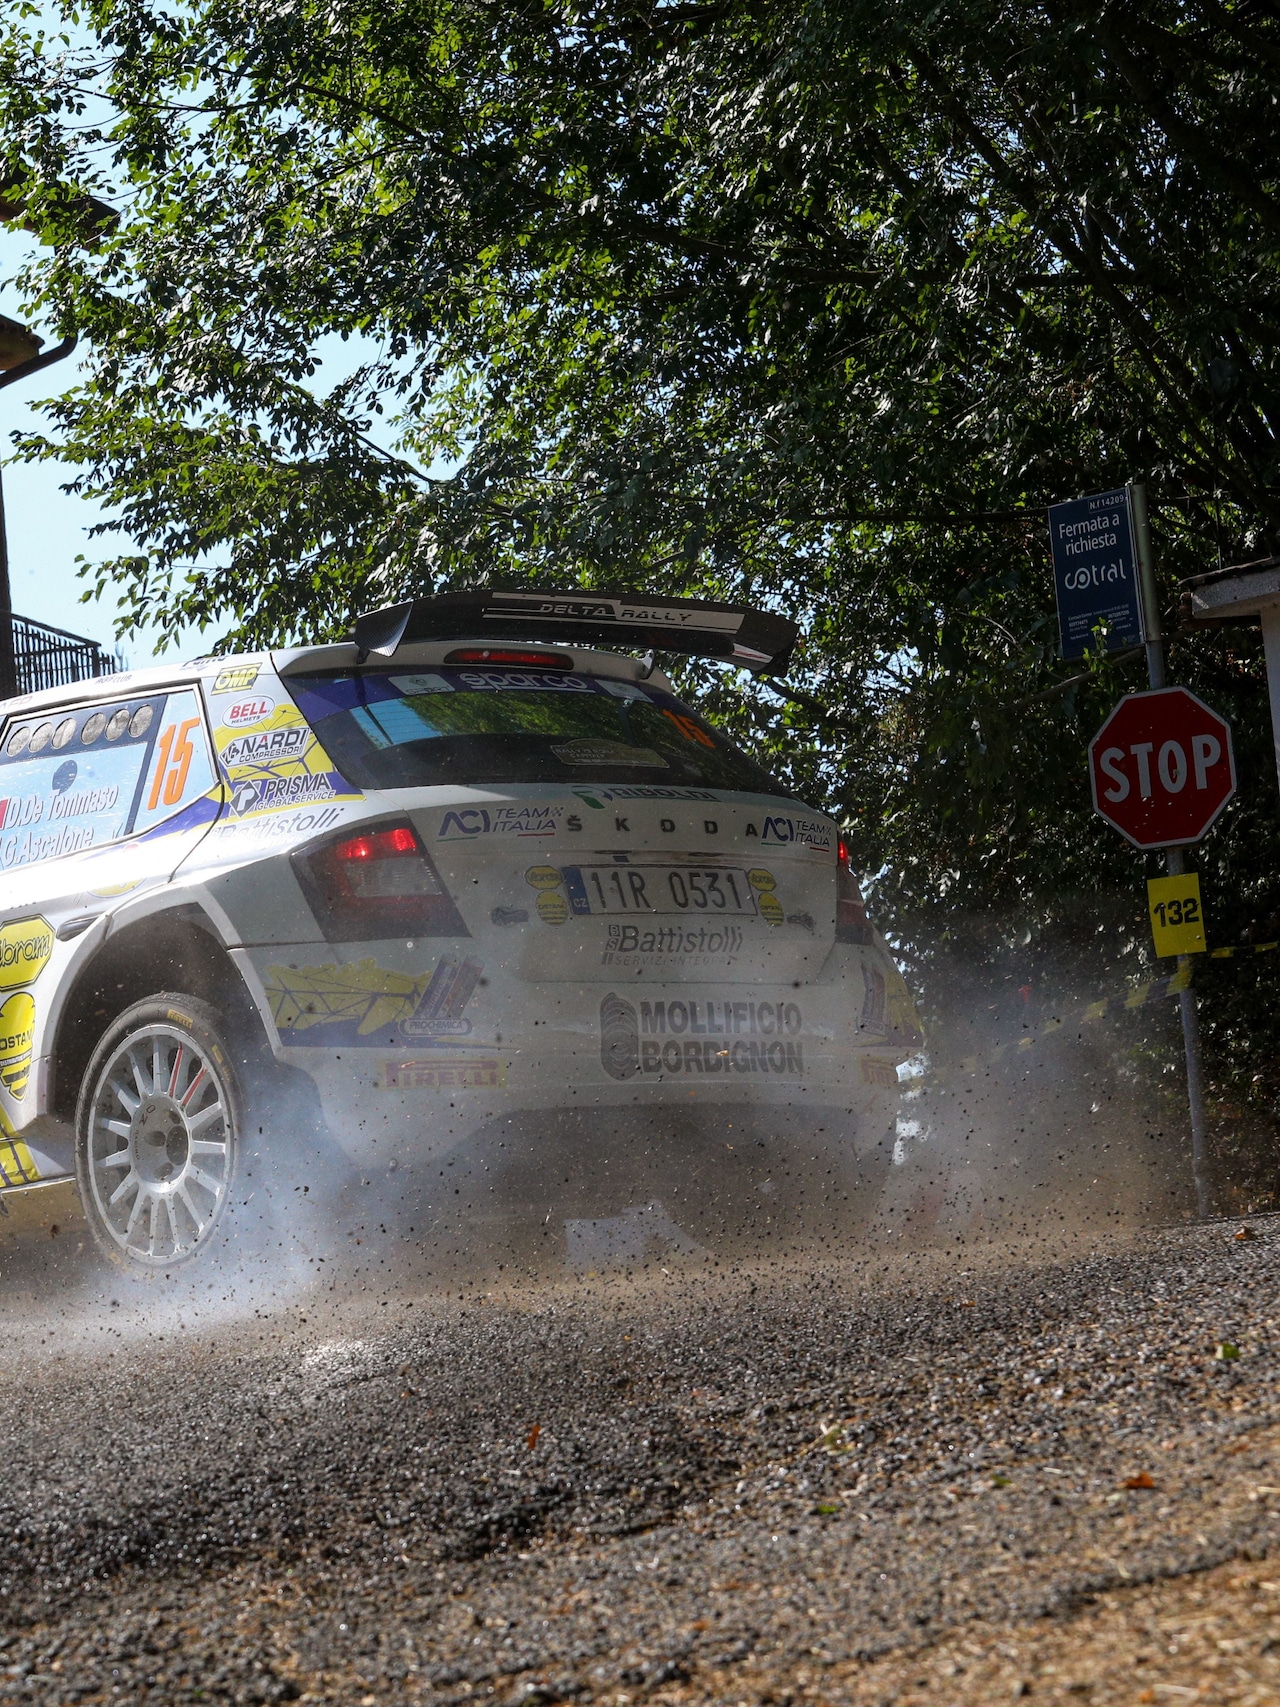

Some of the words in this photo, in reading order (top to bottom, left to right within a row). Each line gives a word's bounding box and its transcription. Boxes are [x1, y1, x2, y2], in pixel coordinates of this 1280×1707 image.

[1101, 494, 1124, 507] 14209
[1059, 515, 1109, 539] Fermata
[1112, 513, 1120, 526] a
[1065, 532, 1117, 556] richiesta
[1064, 558, 1127, 590] cotral
[539, 603, 608, 618] DELTA
[620, 609, 693, 622] RALLY
[214, 667, 258, 690] OMP
[458, 672, 589, 691] sparco
[229, 701, 268, 719] BELL
[231, 714, 261, 724] HELMETS
[240, 729, 308, 755] NARDI
[662, 709, 716, 749] 15
[147, 716, 201, 811] 15
[239, 746, 304, 763] COMPRESSORI
[1099, 733, 1222, 803] STOP
[264, 772, 331, 800] PRISMA
[46, 784, 120, 821] Tommaso
[257, 796, 293, 811] GLOBAL
[295, 791, 335, 805] SERVICE
[438, 809, 491, 836] ACI
[495, 806, 550, 819] TEAM
[492, 819, 557, 832] ITALIA
[761, 816, 796, 842] ACI
[796, 820, 826, 837] TEAM
[4, 825, 95, 867] G.Ascalone
[794, 832, 831, 847] ITALIA
[573, 897, 589, 908] CZ
[591, 870, 651, 909] 11R
[668, 870, 743, 909] 0531
[1153, 897, 1200, 928] 132
[617, 924, 744, 953] Battistolli
[615, 955, 667, 966] SERVIZI
[166, 1008, 194, 1030] PIRELLI
[640, 1000, 803, 1035] MOLLIFICIO
[641, 1040, 805, 1075] BORDIGNON
[385, 1060, 498, 1088] PIRELLI
